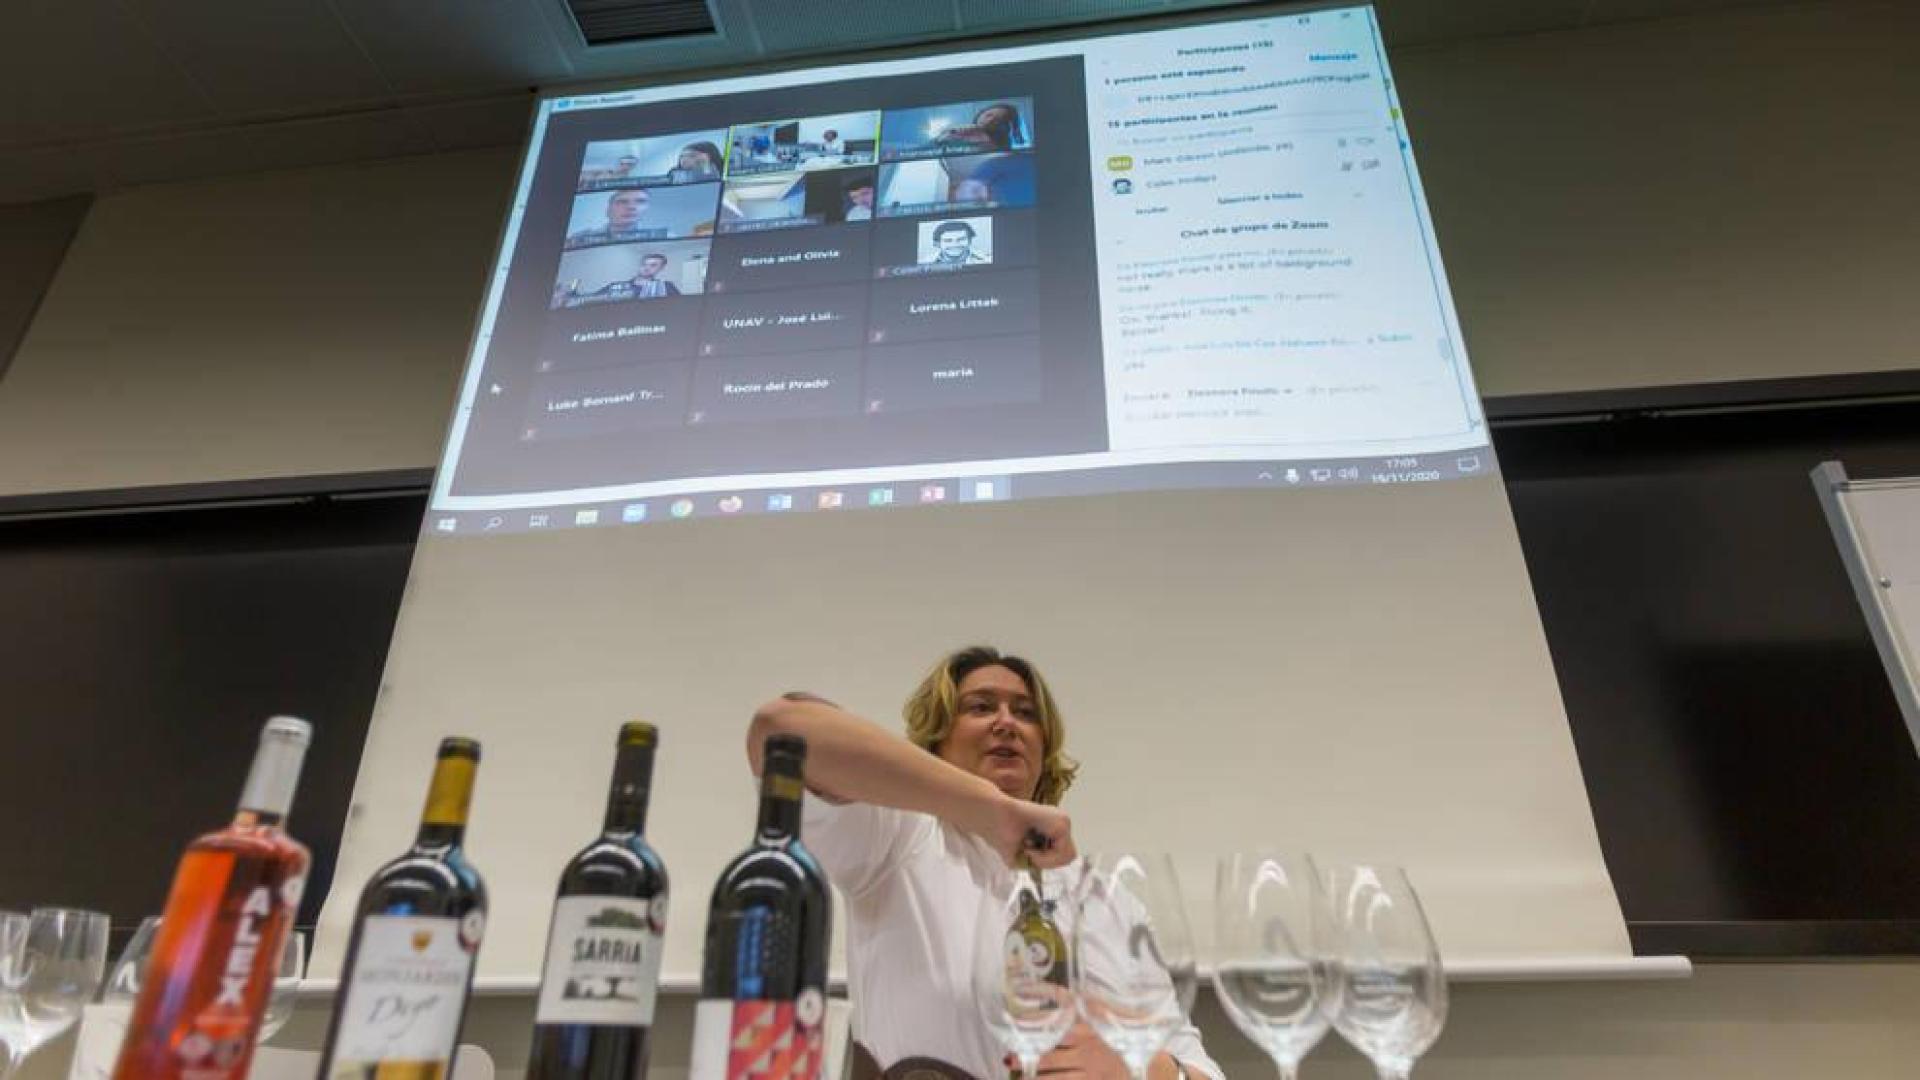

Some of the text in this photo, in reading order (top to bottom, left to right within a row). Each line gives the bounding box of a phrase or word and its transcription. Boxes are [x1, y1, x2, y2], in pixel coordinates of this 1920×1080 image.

[1114, 72, 1158, 86] persona
[1124, 111, 1198, 128] participantes
[1201, 111, 1216, 120] en
[1181, 218, 1329, 239] Chat de grupo de Zoom
[777, 253, 801, 264] and
[804, 247, 841, 262] Olivia
[910, 301, 957, 314] Lorena
[722, 317, 764, 330] UNAV
[763, 380, 786, 392] del
[582, 391, 635, 408] Bernard
[216, 885, 271, 1005] ALEX
